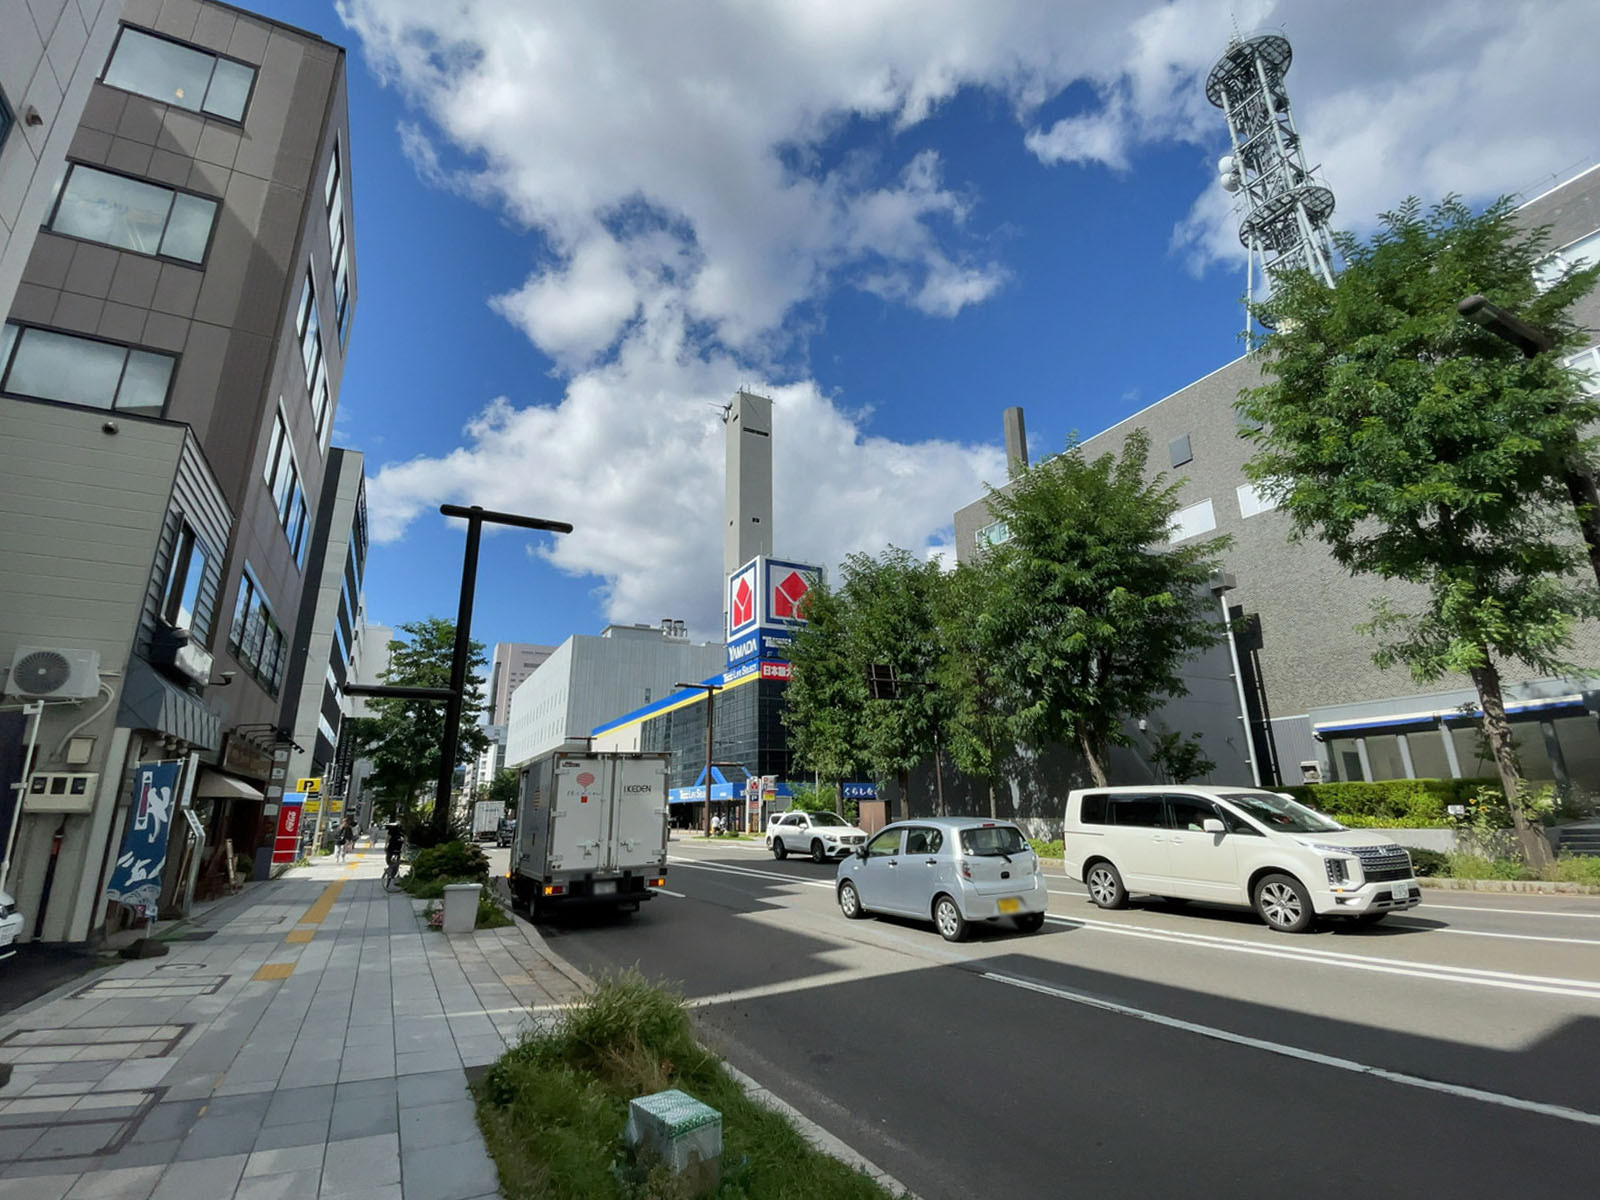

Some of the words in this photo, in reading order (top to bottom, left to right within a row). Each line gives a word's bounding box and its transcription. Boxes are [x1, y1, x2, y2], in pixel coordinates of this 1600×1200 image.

[728, 638, 757, 662] YAMADA
[303, 780, 314, 790] P
[624, 785, 651, 793] IKEDEN
